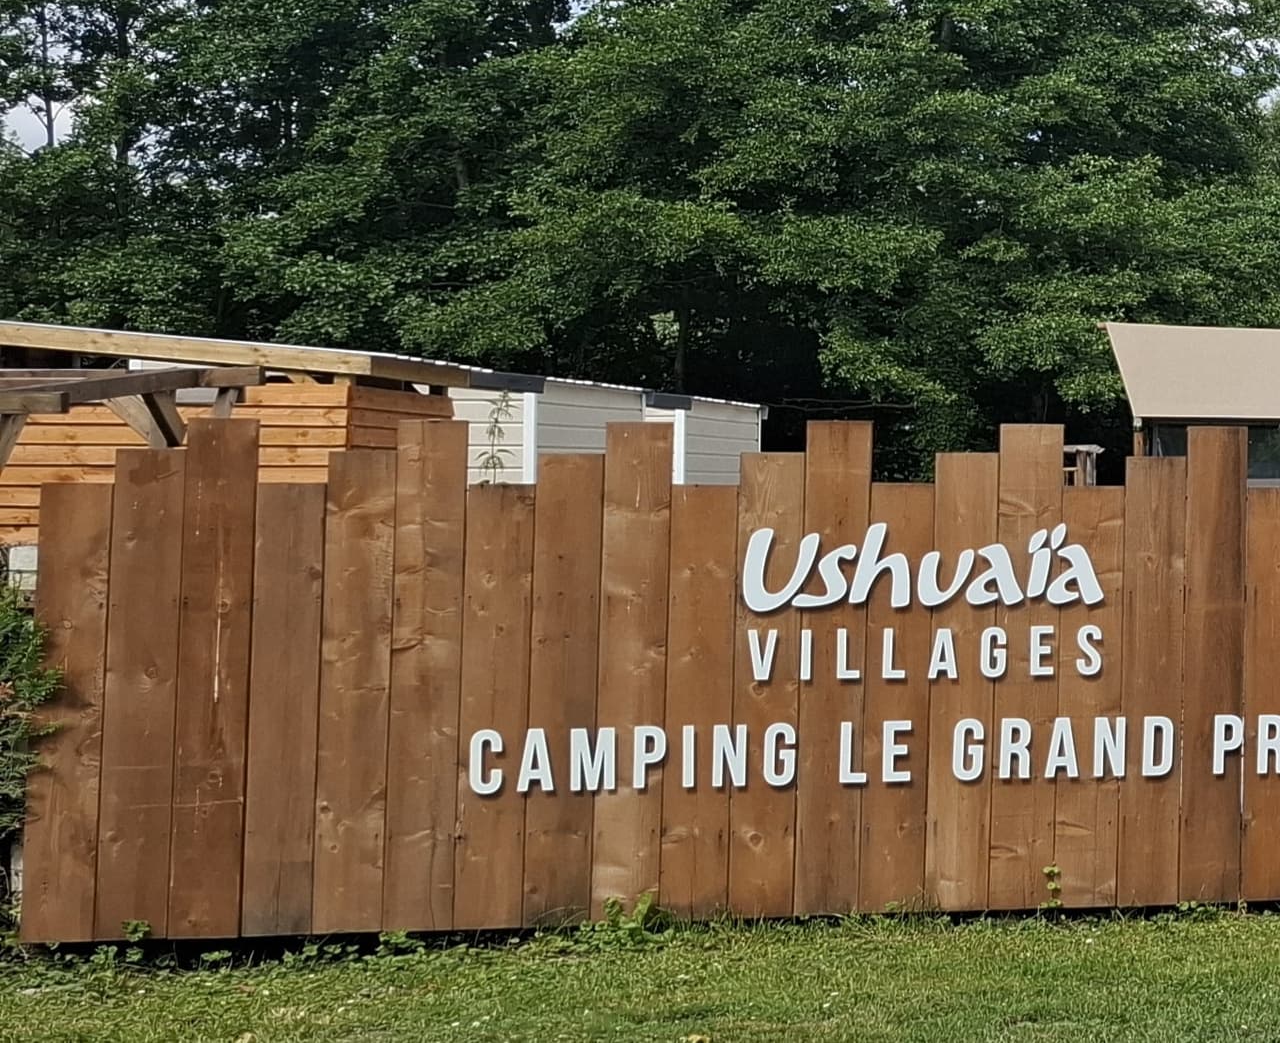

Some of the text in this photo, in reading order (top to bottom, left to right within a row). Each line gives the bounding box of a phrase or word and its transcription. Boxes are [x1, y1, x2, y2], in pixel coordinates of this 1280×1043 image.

[742, 522, 1105, 613] Ushuaïa
[747, 624, 1104, 682] VILLAGES
[468, 722, 797, 795] CAMPING
[839, 720, 913, 784] LE
[952, 715, 1175, 781] GRAND
